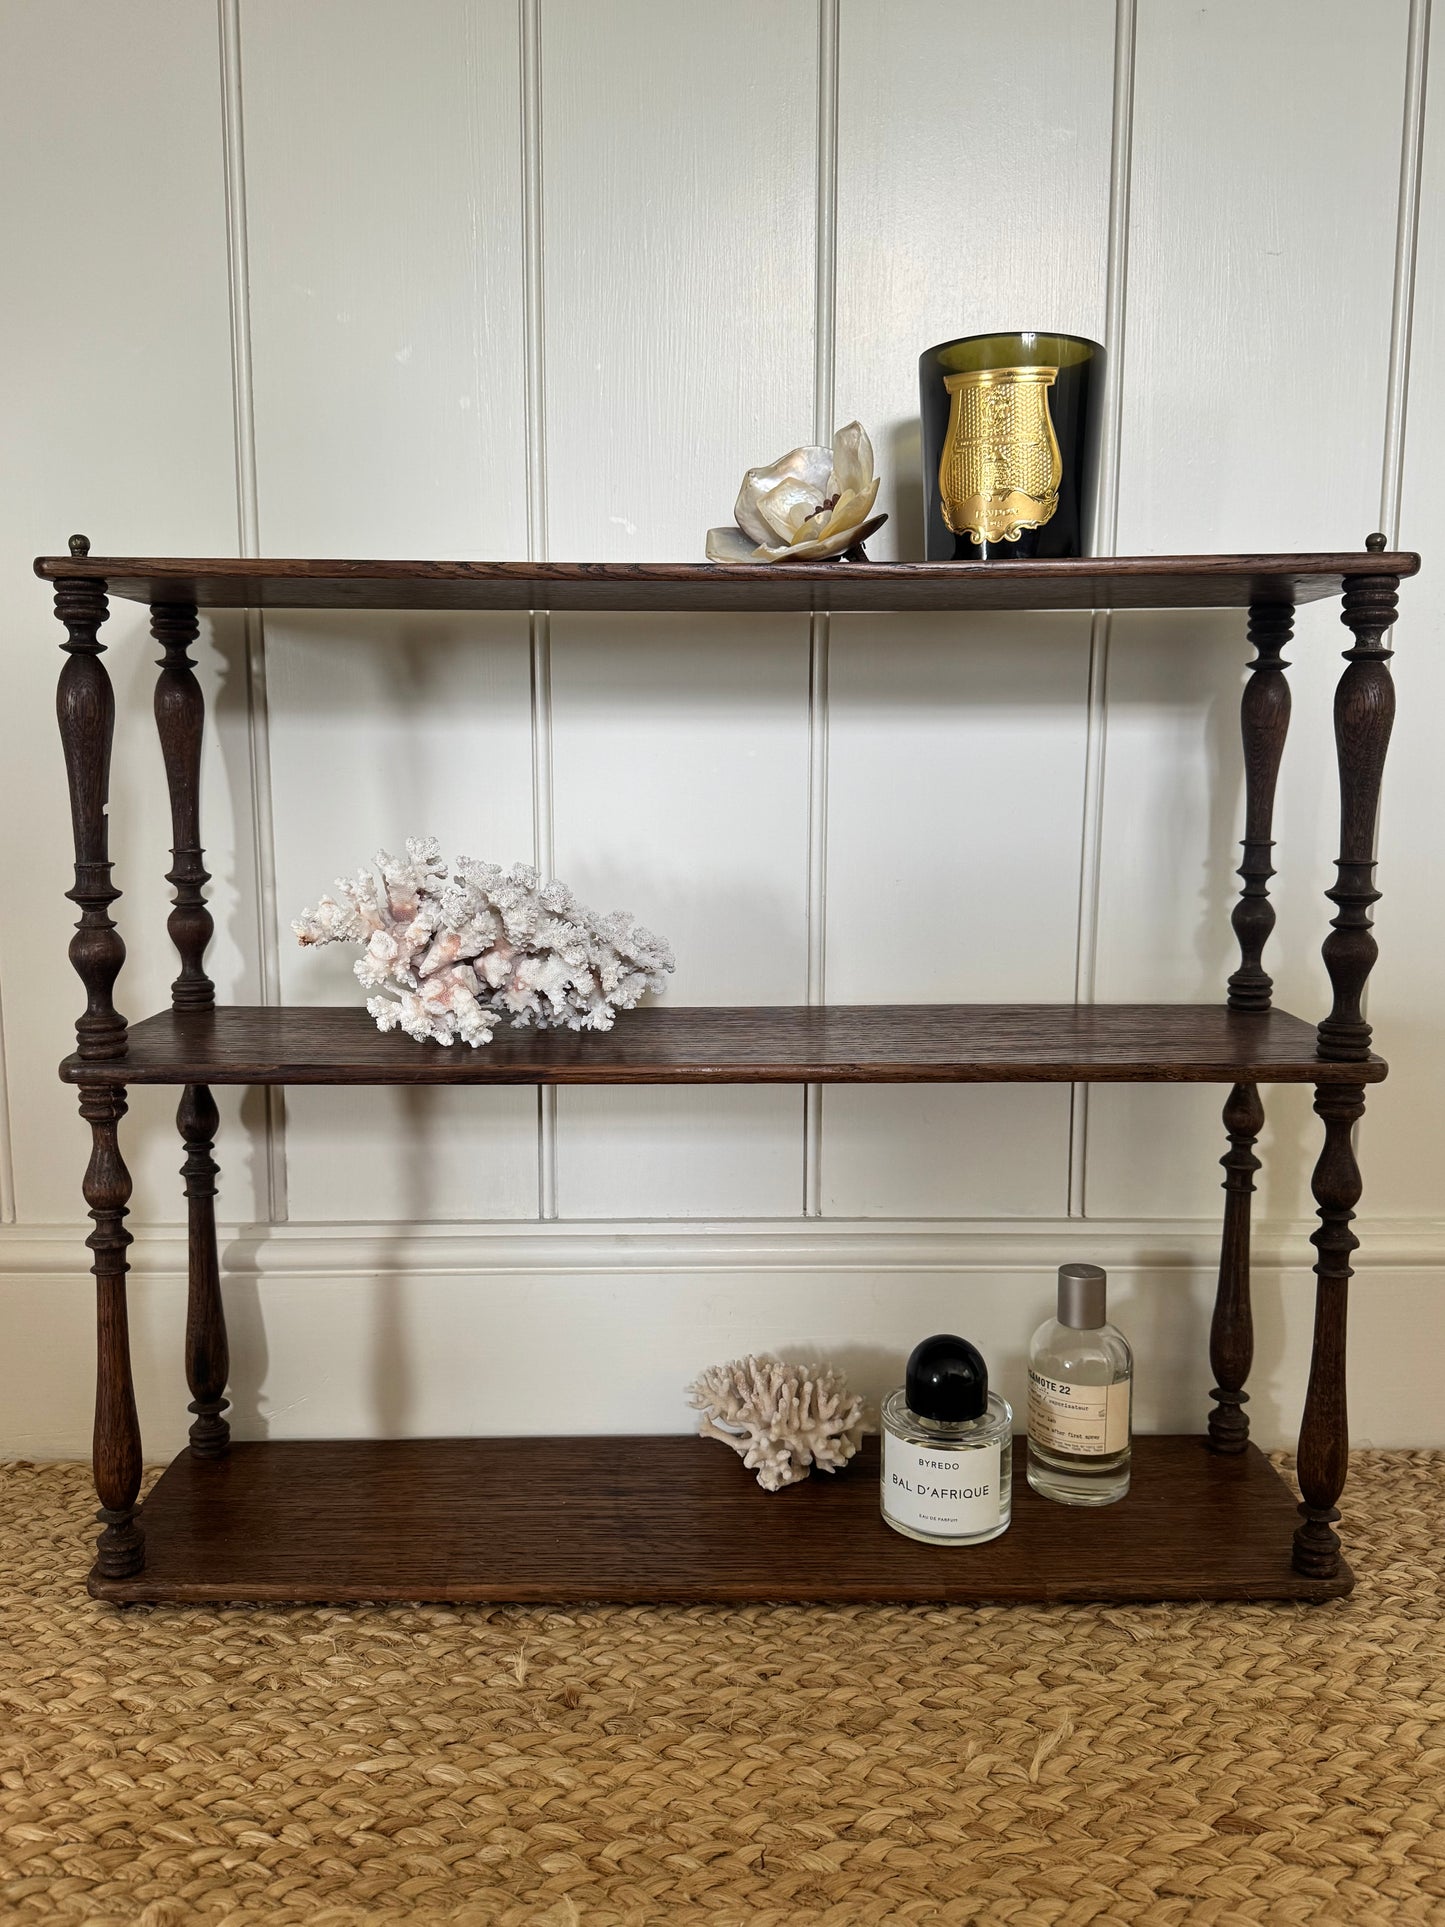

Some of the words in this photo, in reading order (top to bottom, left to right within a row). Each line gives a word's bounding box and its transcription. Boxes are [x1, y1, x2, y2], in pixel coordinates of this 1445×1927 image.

[1059, 1385, 1071, 1395] 22
[918, 1458, 960, 1471] BYREDO
[892, 1473, 913, 1493] BAL
[917, 1484, 990, 1500] D'AFRIQUE
